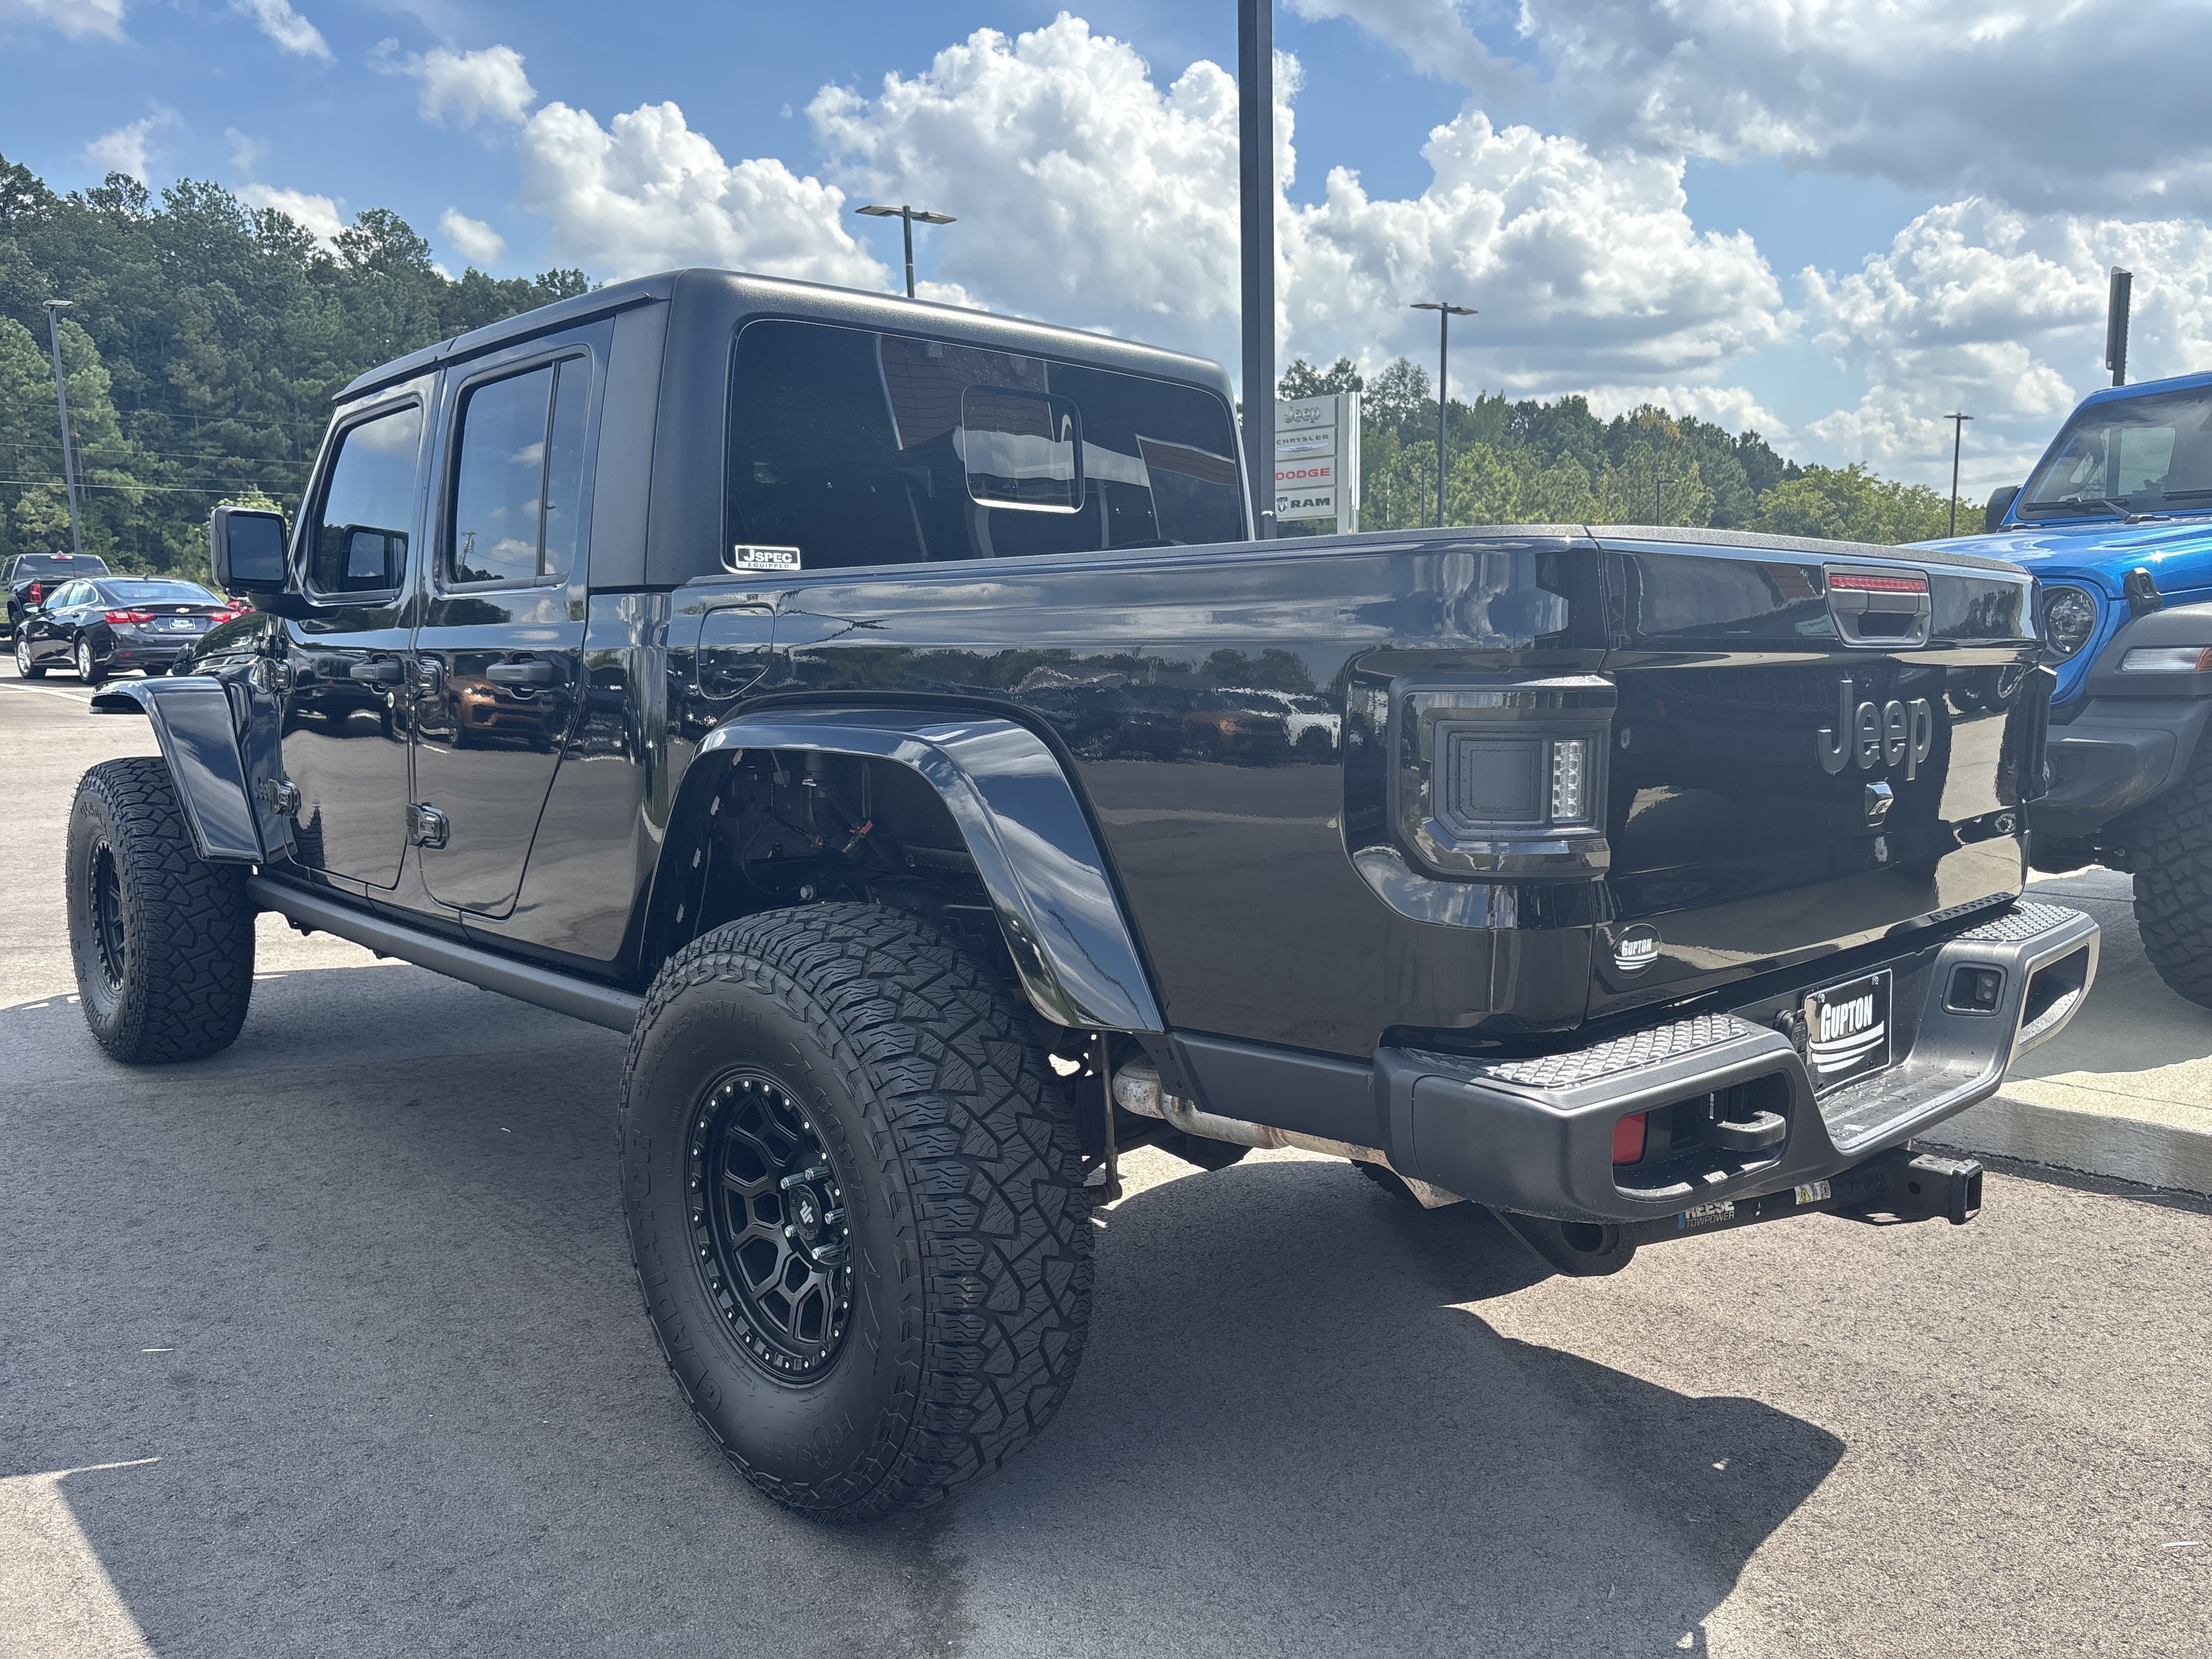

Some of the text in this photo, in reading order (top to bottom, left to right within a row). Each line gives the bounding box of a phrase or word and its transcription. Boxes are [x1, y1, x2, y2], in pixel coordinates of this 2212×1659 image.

[1283, 406, 1321, 424] Jeep
[1276, 434, 1329, 445] CHRYSLER
[1275, 467, 1330, 481] DODGE
[1290, 497, 1330, 509] RAM
[743, 549, 792, 563] JSPEC
[1816, 679, 1932, 781] Jeep
[254, 776, 269, 802] Jee
[1685, 1201, 1735, 1220] REESE
[1685, 1210, 1735, 1228] TOWPOWER
